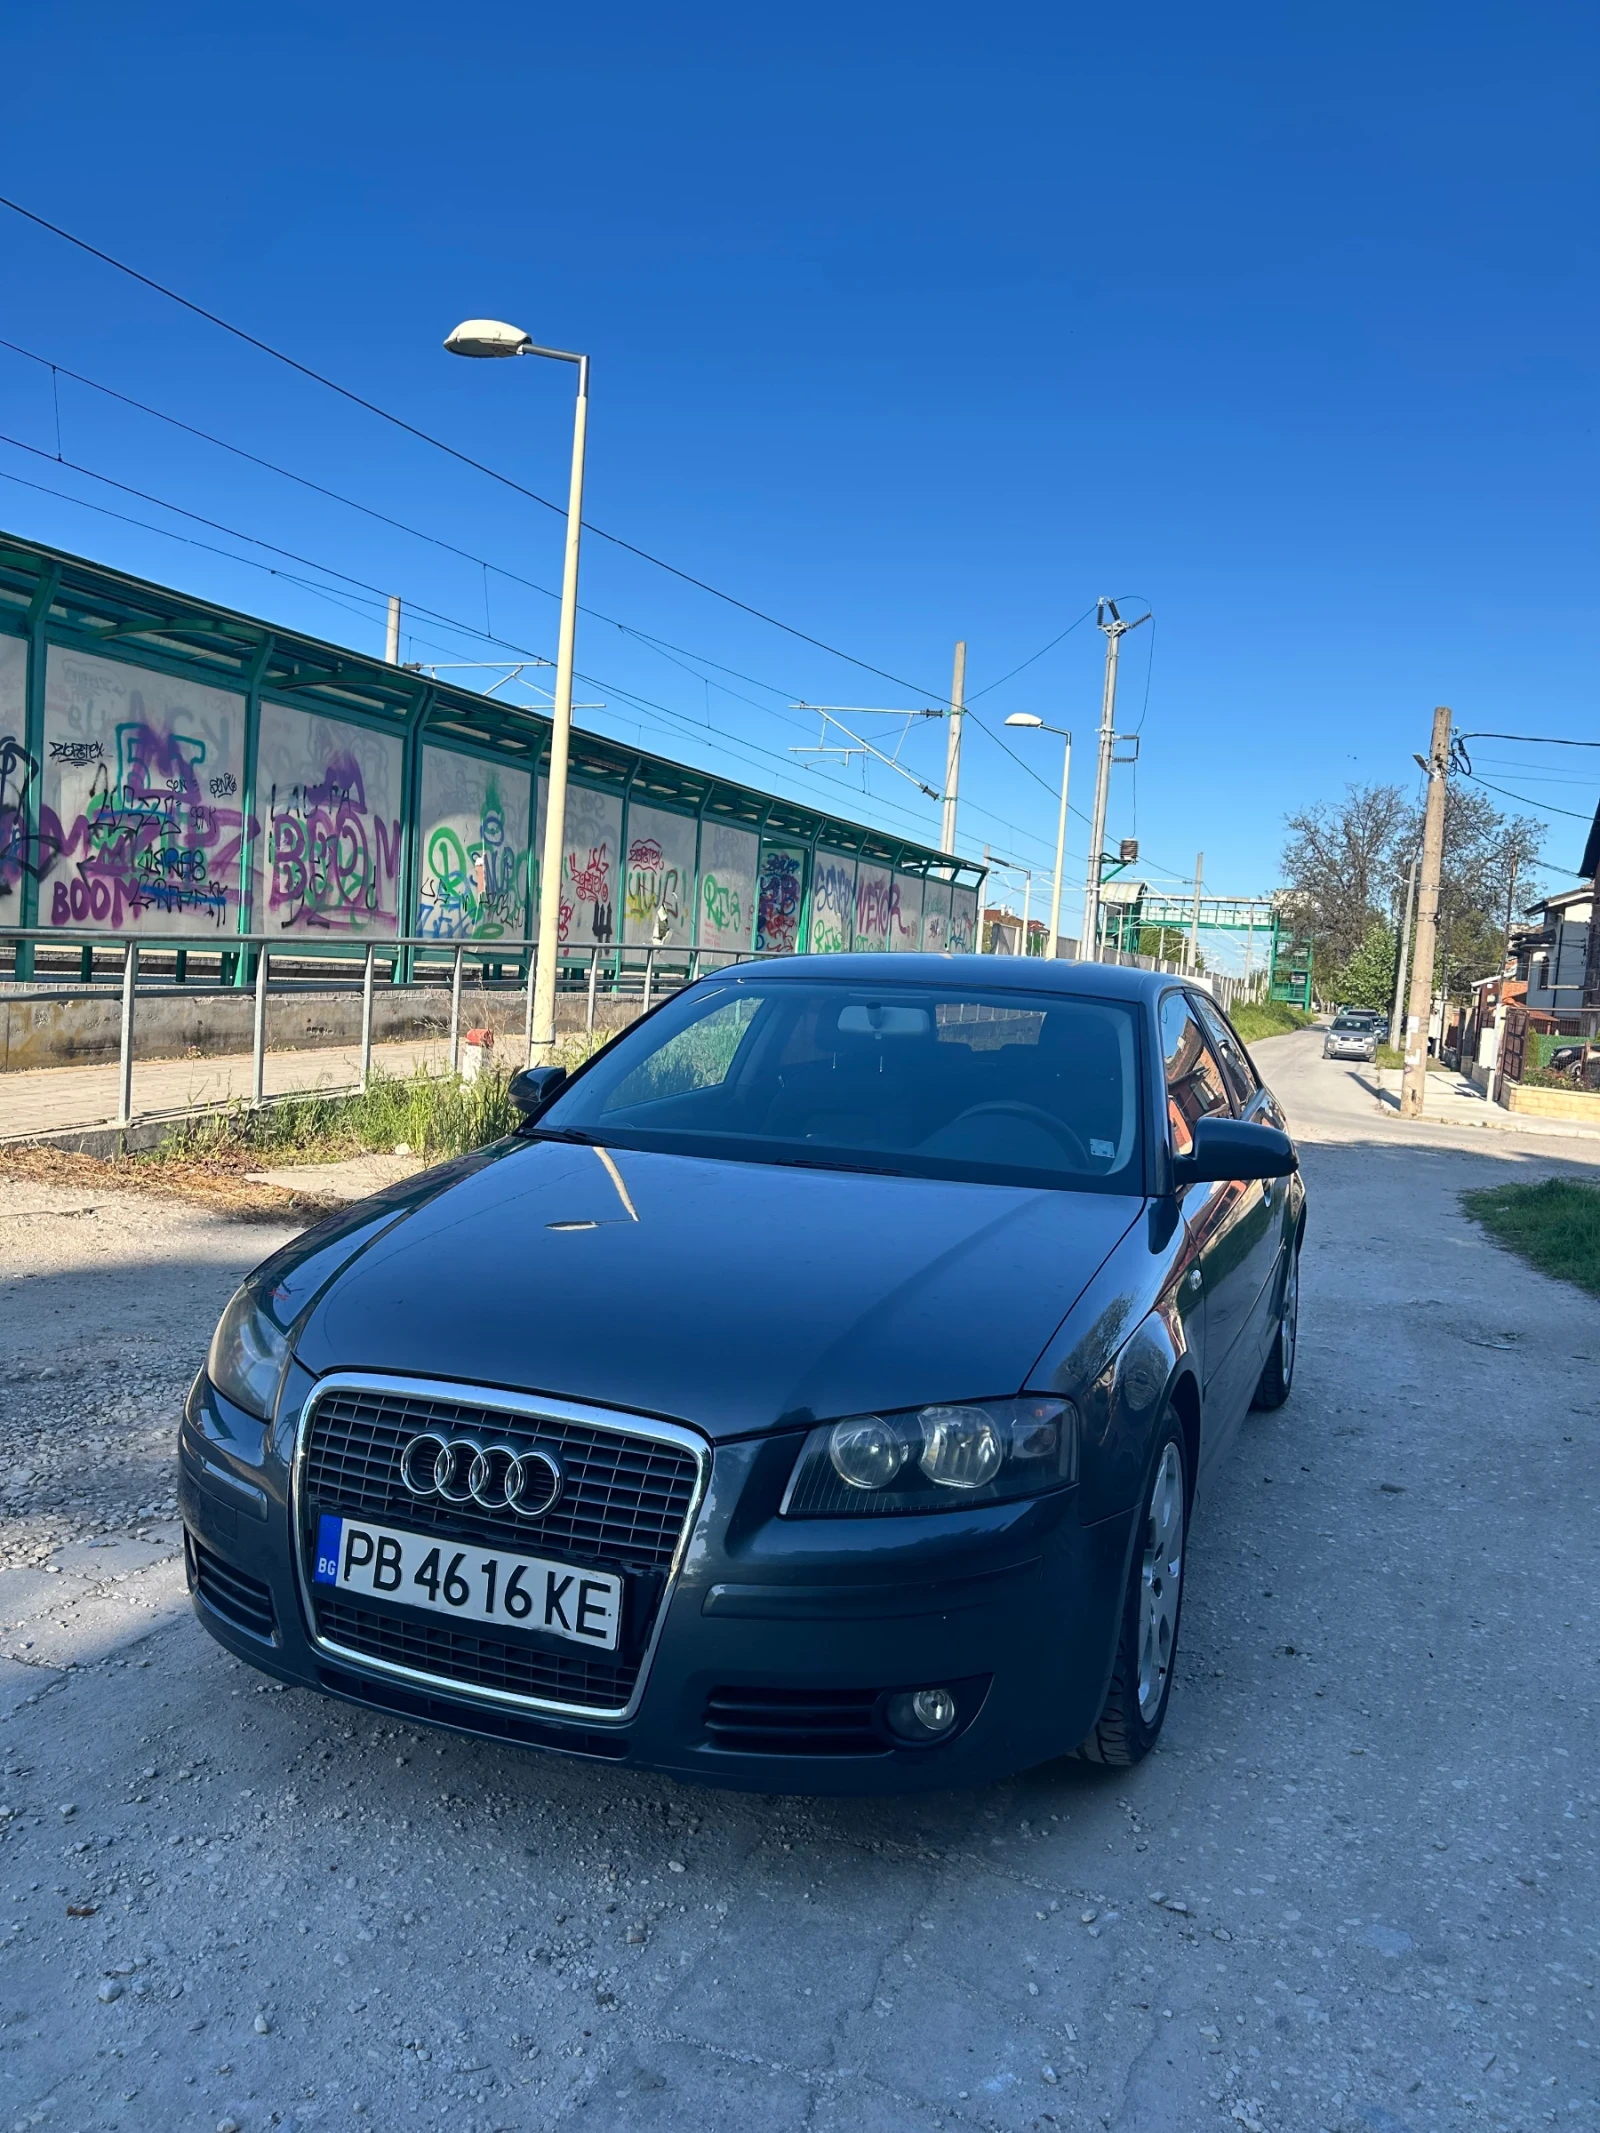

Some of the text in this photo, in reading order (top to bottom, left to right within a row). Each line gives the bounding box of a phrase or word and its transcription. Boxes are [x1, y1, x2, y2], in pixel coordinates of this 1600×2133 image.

[317, 1557, 336, 1576] BG
[344, 1528, 611, 1640] PB 4616 KE
